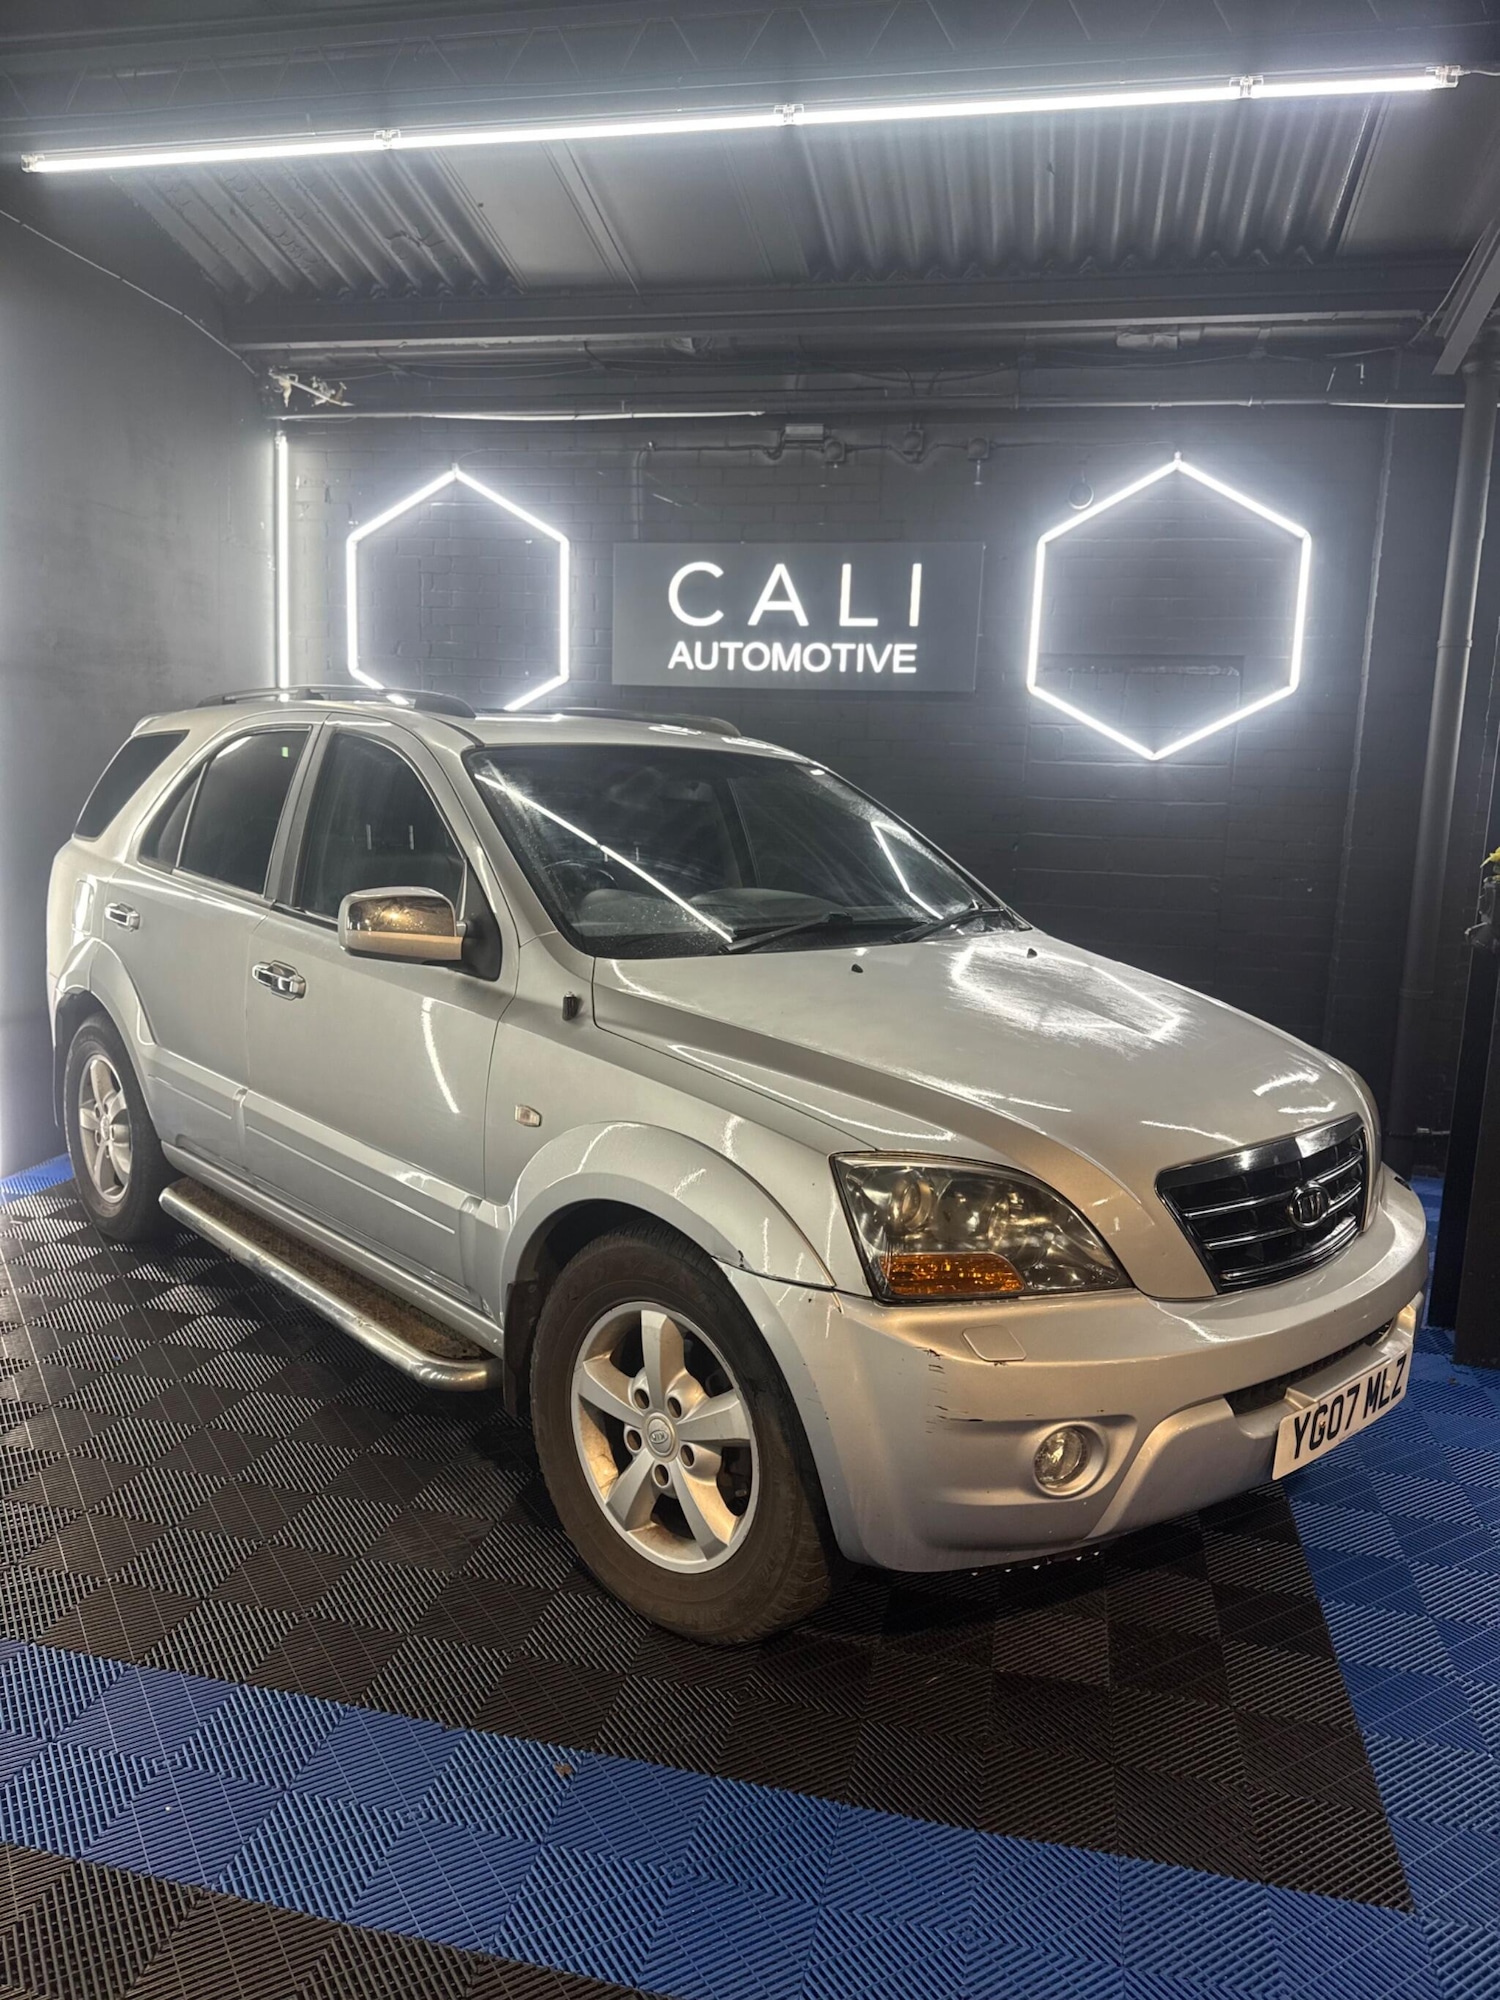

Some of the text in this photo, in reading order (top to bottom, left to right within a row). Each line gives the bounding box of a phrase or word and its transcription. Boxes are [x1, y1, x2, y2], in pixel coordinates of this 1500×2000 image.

[668, 561, 922, 627] CALI
[668, 641, 918, 673] AUTOMOTIVE
[1294, 1353, 1407, 1459] YG07 MLZ
